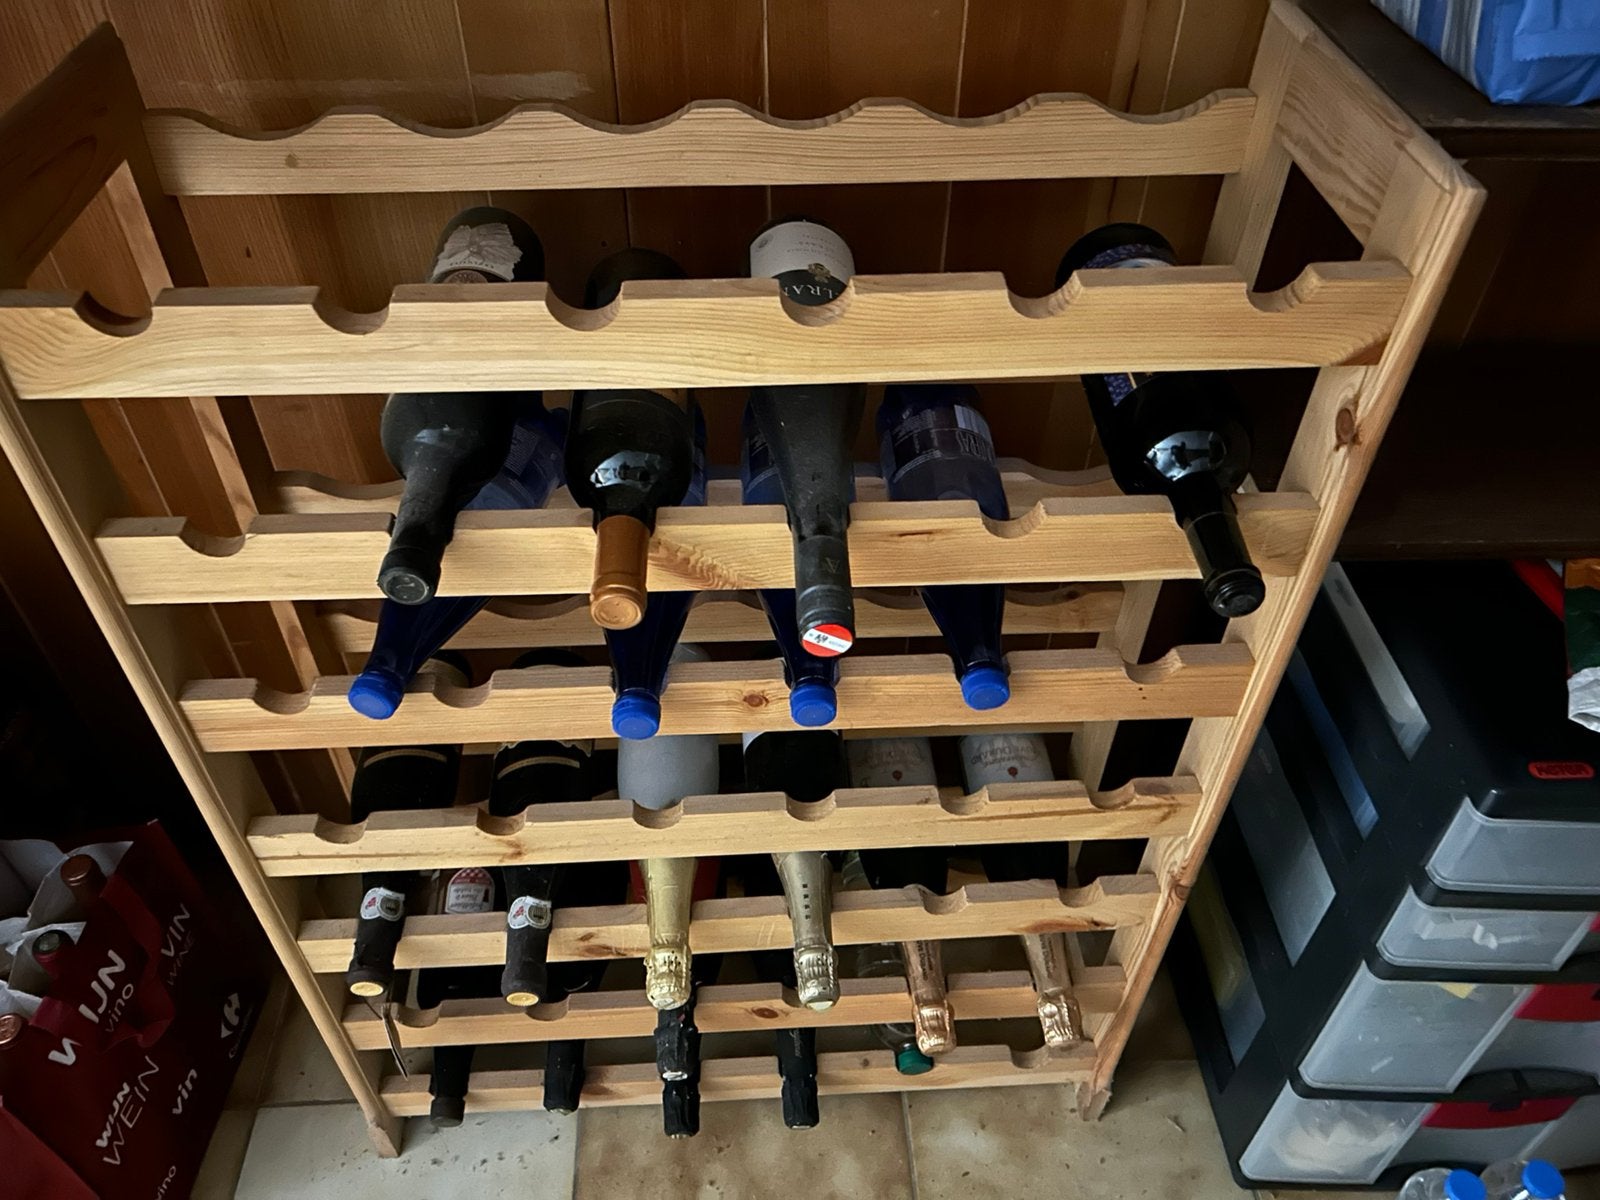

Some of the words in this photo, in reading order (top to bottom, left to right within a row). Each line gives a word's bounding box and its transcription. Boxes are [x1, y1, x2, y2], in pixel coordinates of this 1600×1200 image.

[161, 903, 190, 957] VIN
[105, 983, 134, 1032] vino
[96, 1082, 130, 1147] WIJN
[102, 1055, 159, 1165] WEIN
[172, 1069, 198, 1114] vin
